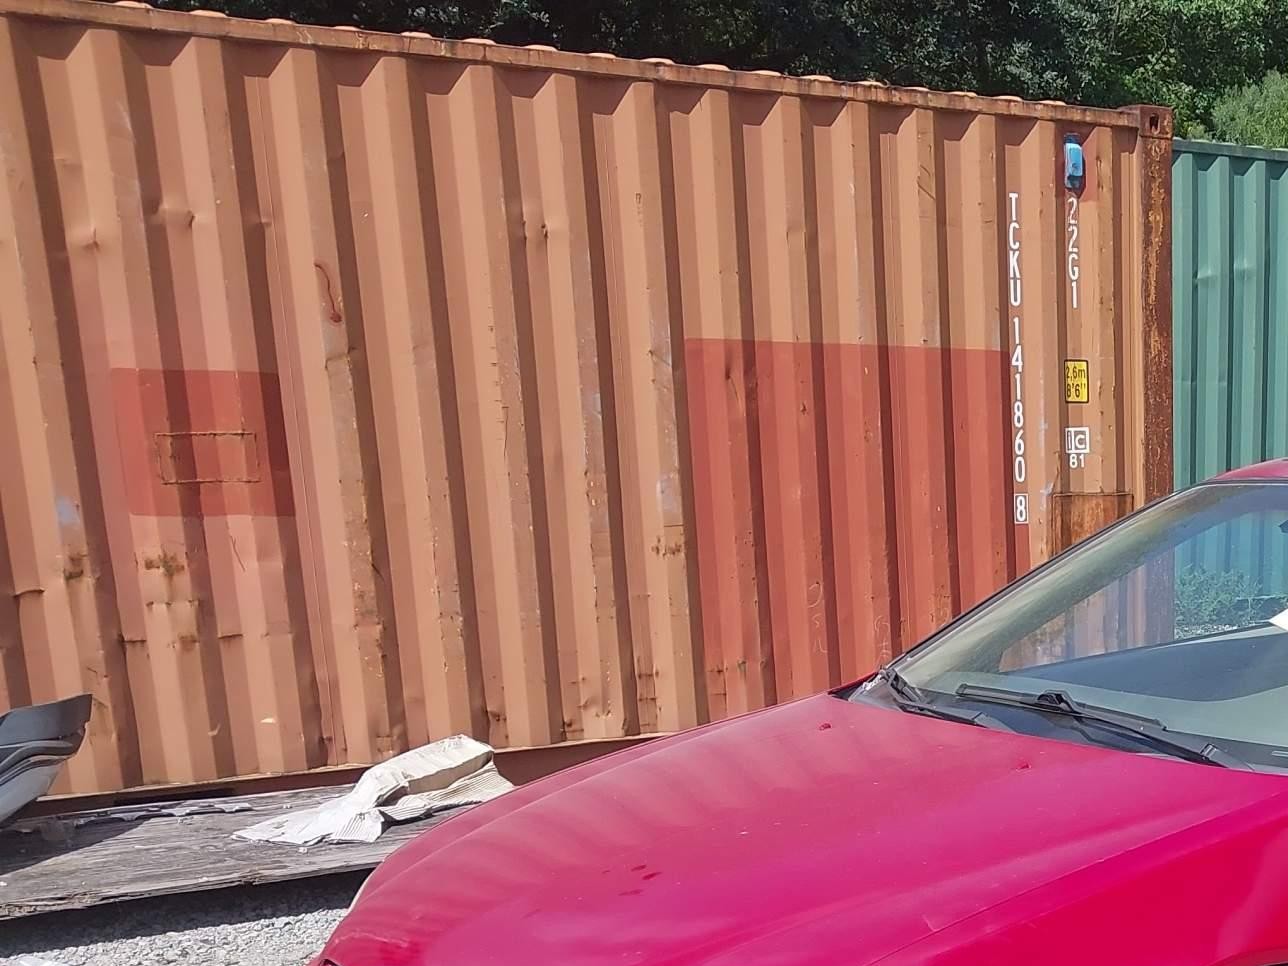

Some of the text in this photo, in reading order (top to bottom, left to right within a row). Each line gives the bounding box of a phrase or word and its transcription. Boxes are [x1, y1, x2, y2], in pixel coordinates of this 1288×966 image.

[1067, 196, 1079, 309] 22G1
[1008, 192, 1027, 522] TCKU 141860 8
[1069, 454, 1085, 469] 81
